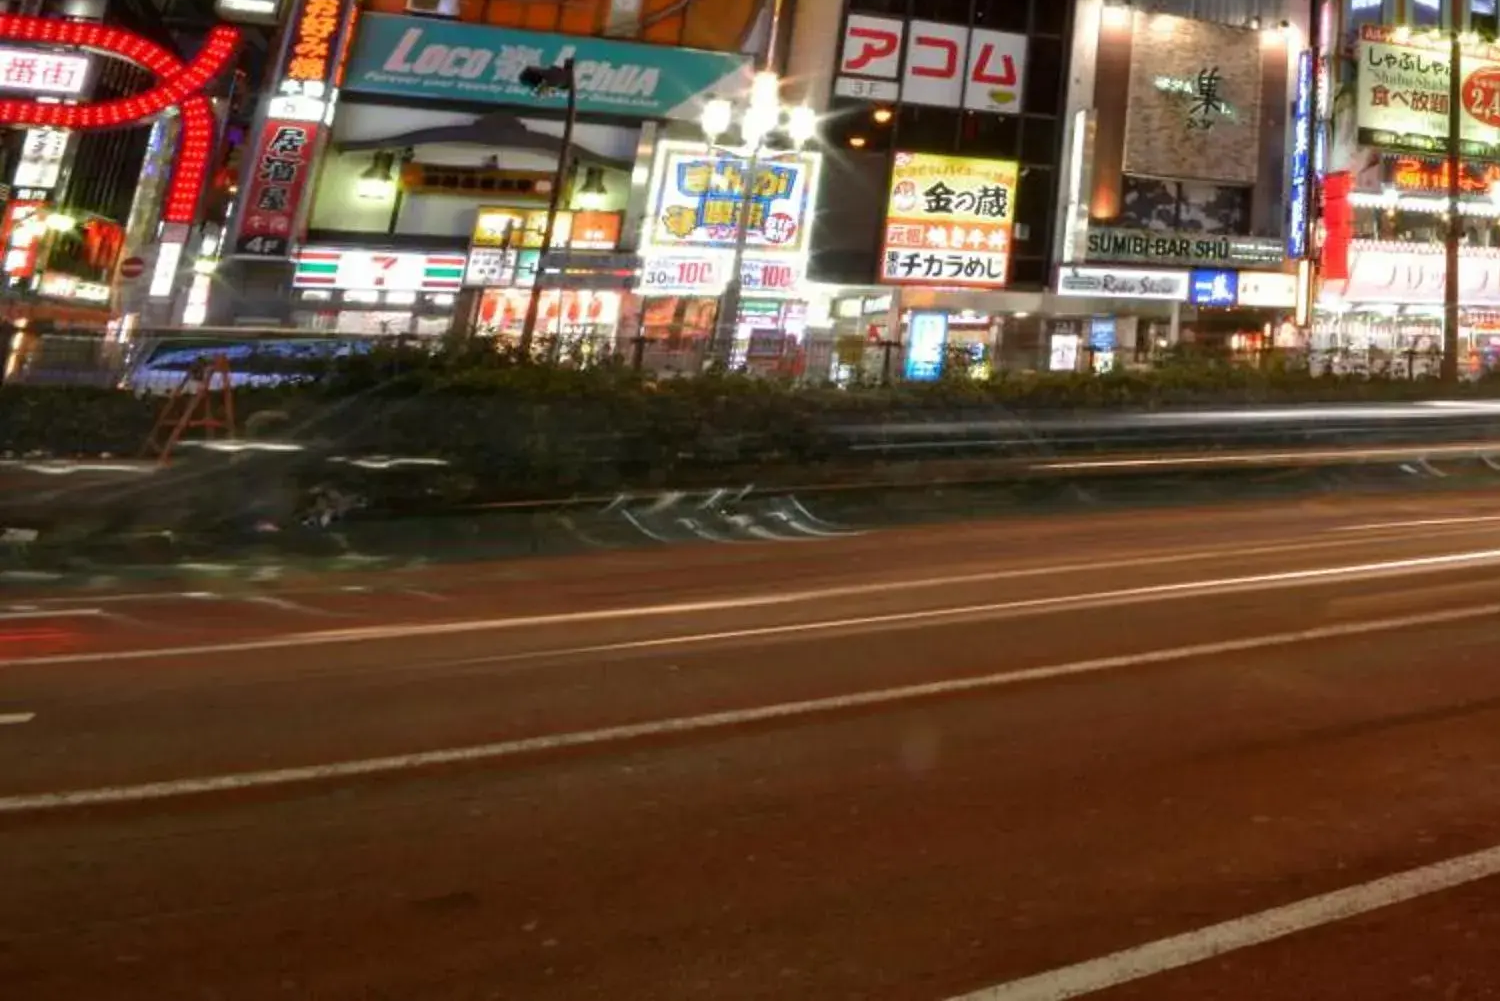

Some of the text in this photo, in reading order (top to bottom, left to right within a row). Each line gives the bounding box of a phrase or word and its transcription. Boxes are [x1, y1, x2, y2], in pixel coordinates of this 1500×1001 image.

[844, 27, 1018, 86] アコム
[1368, 47, 1451, 76] しゃぶしゃ
[254, 126, 306, 211] 居酒屋
[1087, 233, 1191, 257] SUMIBI-BAR
[899, 251, 1003, 280] チカラめし
